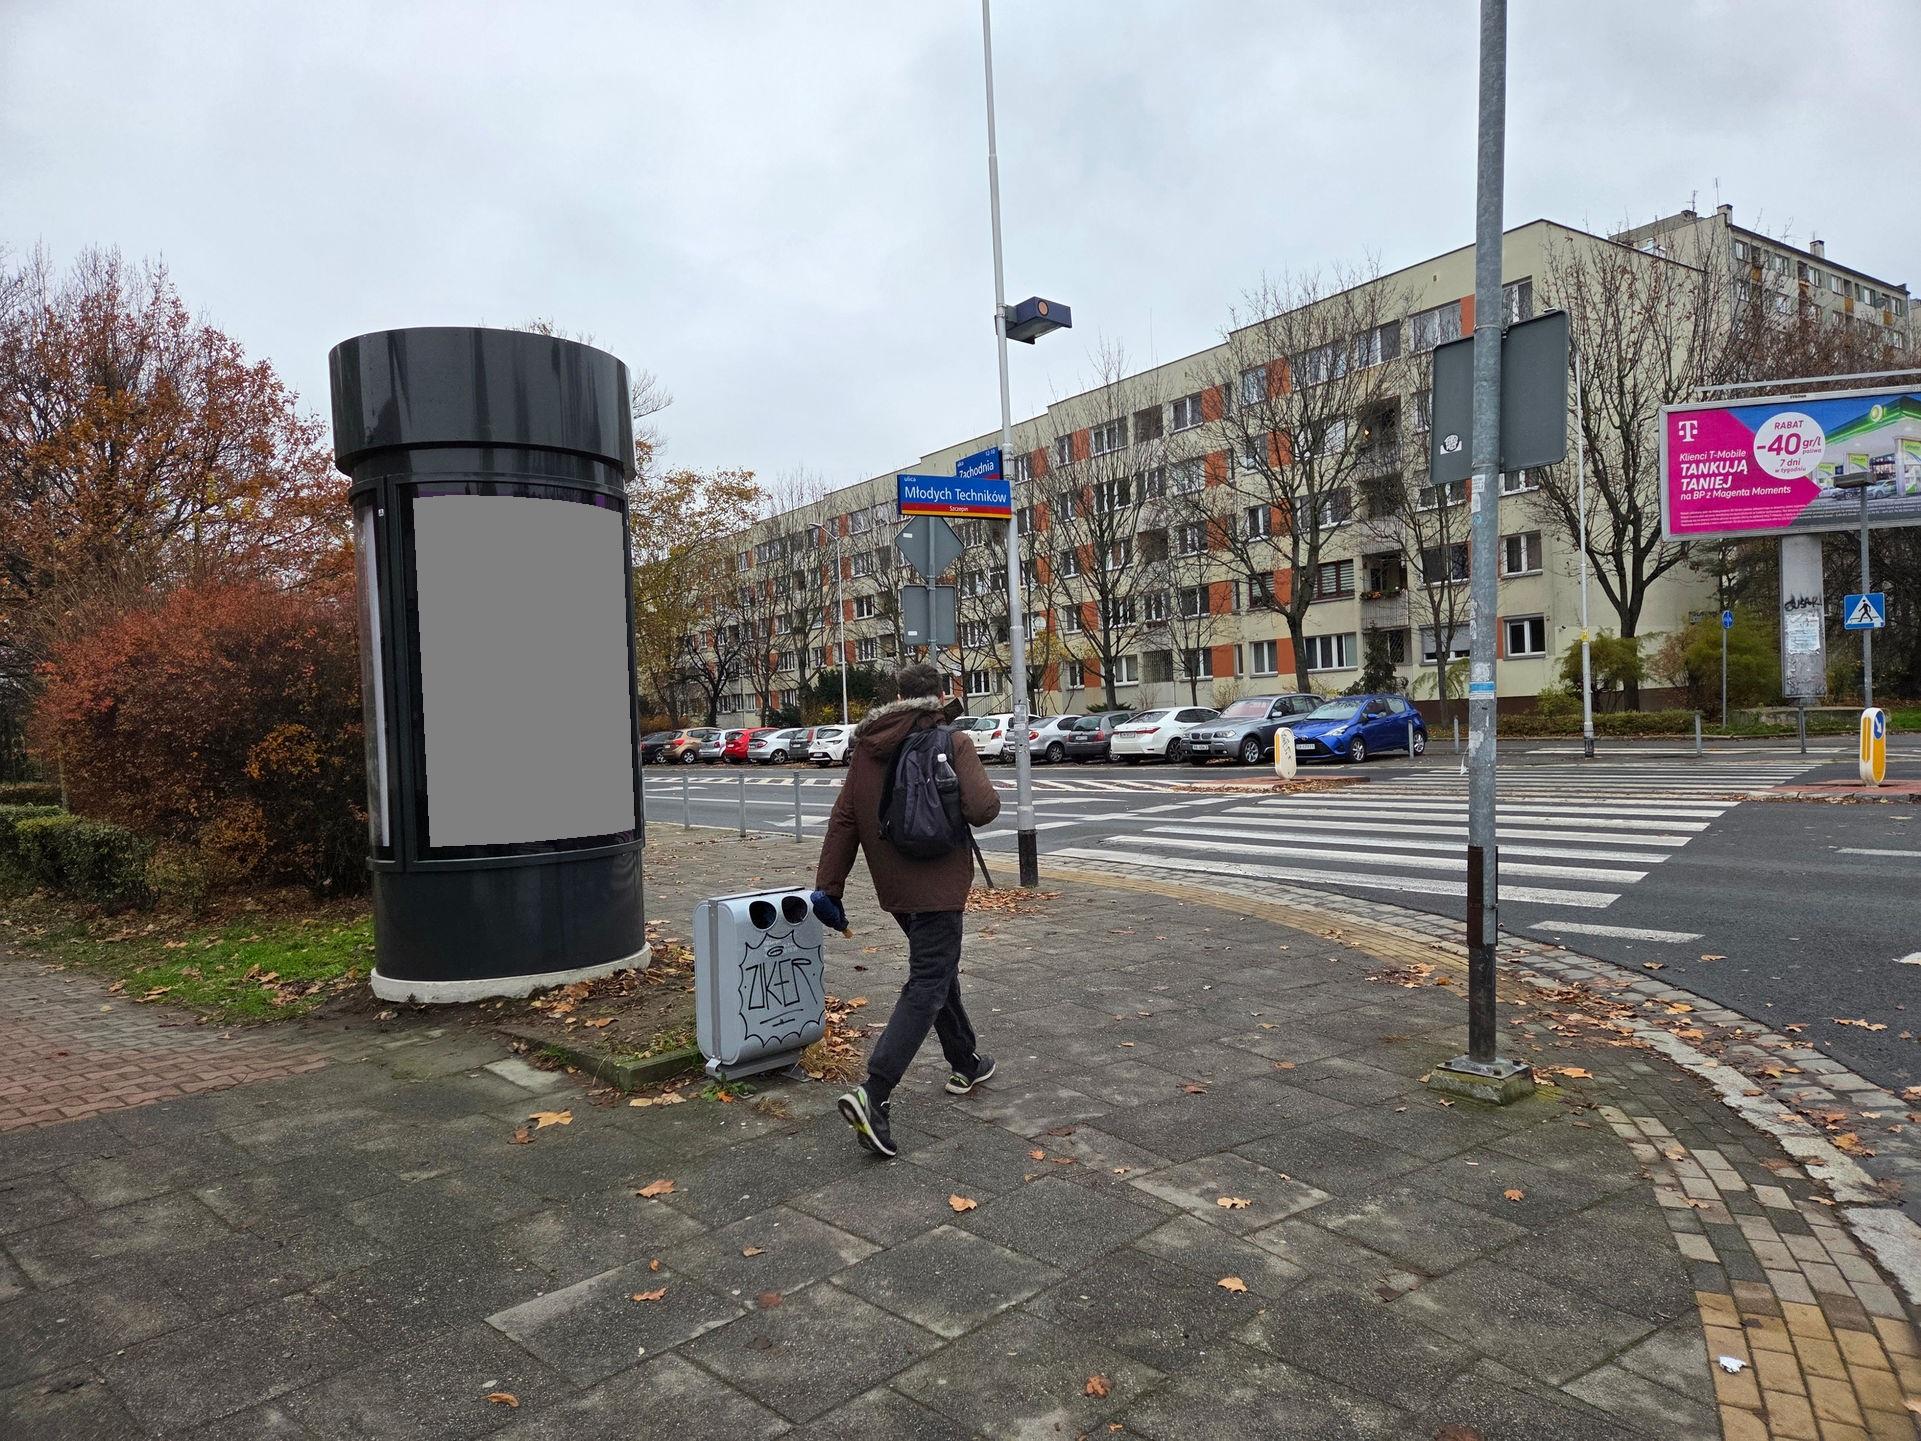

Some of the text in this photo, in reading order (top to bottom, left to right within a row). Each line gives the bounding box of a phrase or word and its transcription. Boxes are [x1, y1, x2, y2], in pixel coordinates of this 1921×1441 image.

[1774, 420, 1804, 430] RABAT
[1757, 433, 1821, 456] -40 gr/l
[1680, 449, 1747, 462] Klienci T-Mobile
[1780, 458, 1801, 467] 7 dni
[959, 460, 994, 478] Zachodnia
[1681, 460, 1748, 476] TANKUJĄ
[1681, 476, 1733, 491] TANIEJ
[904, 486, 1007, 503] Młodych Techników
[1681, 493, 1692, 501] na
[1693, 490, 1706, 500] BP
[1713, 488, 1750, 499] Magenta
[1752, 485, 1791, 496] Moments
[949, 505, 969, 513] Szczepin
